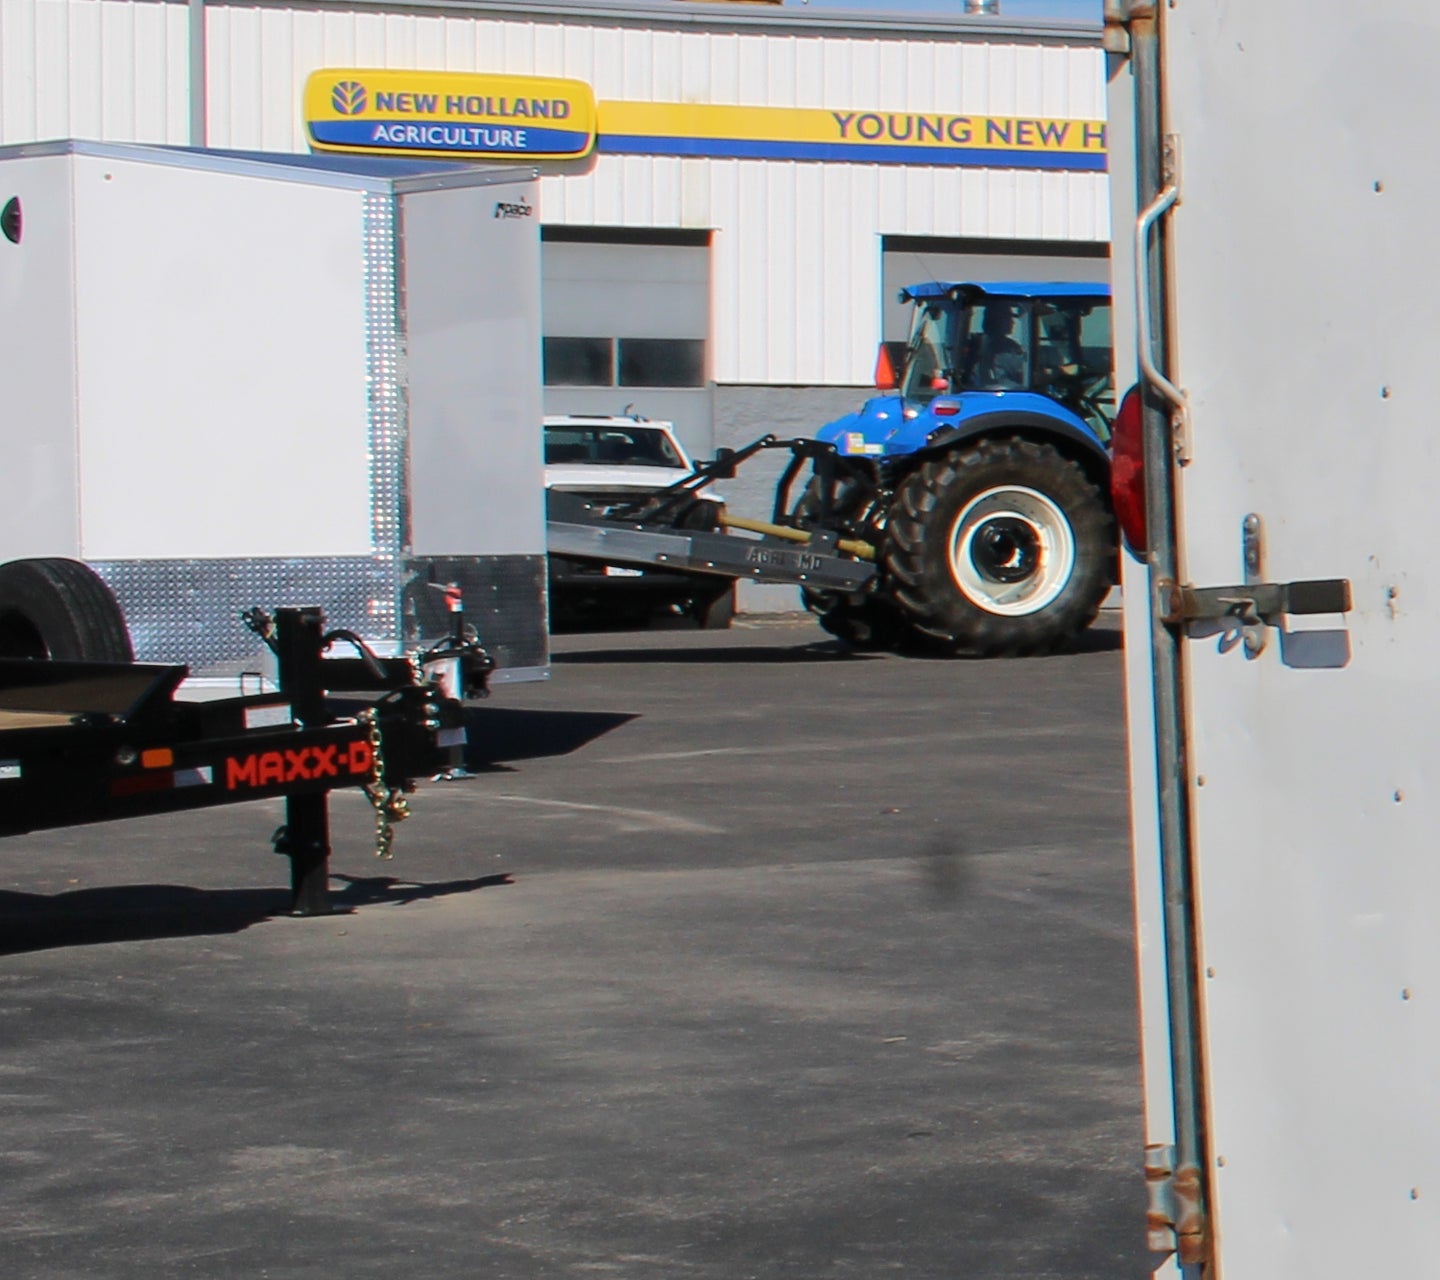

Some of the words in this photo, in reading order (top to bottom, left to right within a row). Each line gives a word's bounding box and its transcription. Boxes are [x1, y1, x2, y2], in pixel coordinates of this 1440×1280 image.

[375, 91, 438, 115] NEW
[446, 94, 571, 120] HOLLAND
[372, 124, 528, 148] AGRICULTURE
[832, 111, 972, 144] YOUNG
[986, 118, 1070, 147] NEW
[226, 741, 372, 790] MAXX-D
